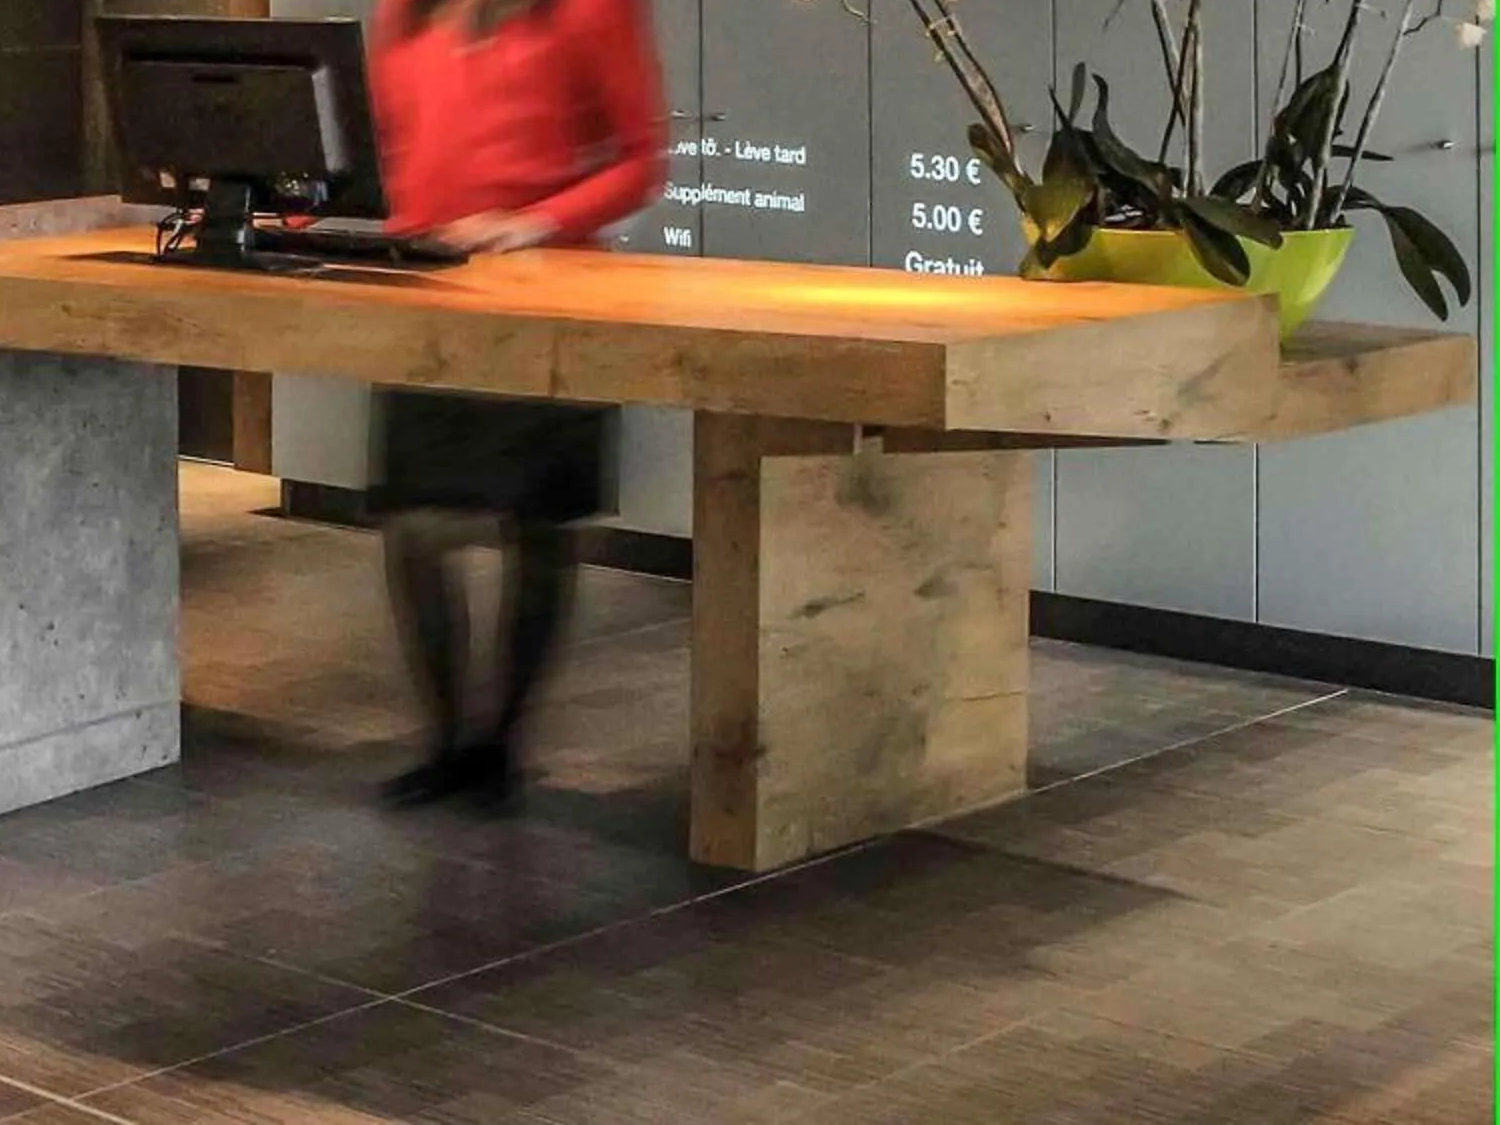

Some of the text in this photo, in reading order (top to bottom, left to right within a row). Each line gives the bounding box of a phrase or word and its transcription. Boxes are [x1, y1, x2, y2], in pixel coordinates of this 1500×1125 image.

[773, 144, 807, 165] tard
[910, 152, 982, 185] 5.30 €
[663, 180, 805, 212] Supplément animal
[912, 202, 984, 236] 5.00 €
[663, 226, 692, 248] Wifi
[905, 250, 985, 275] Gratuit
